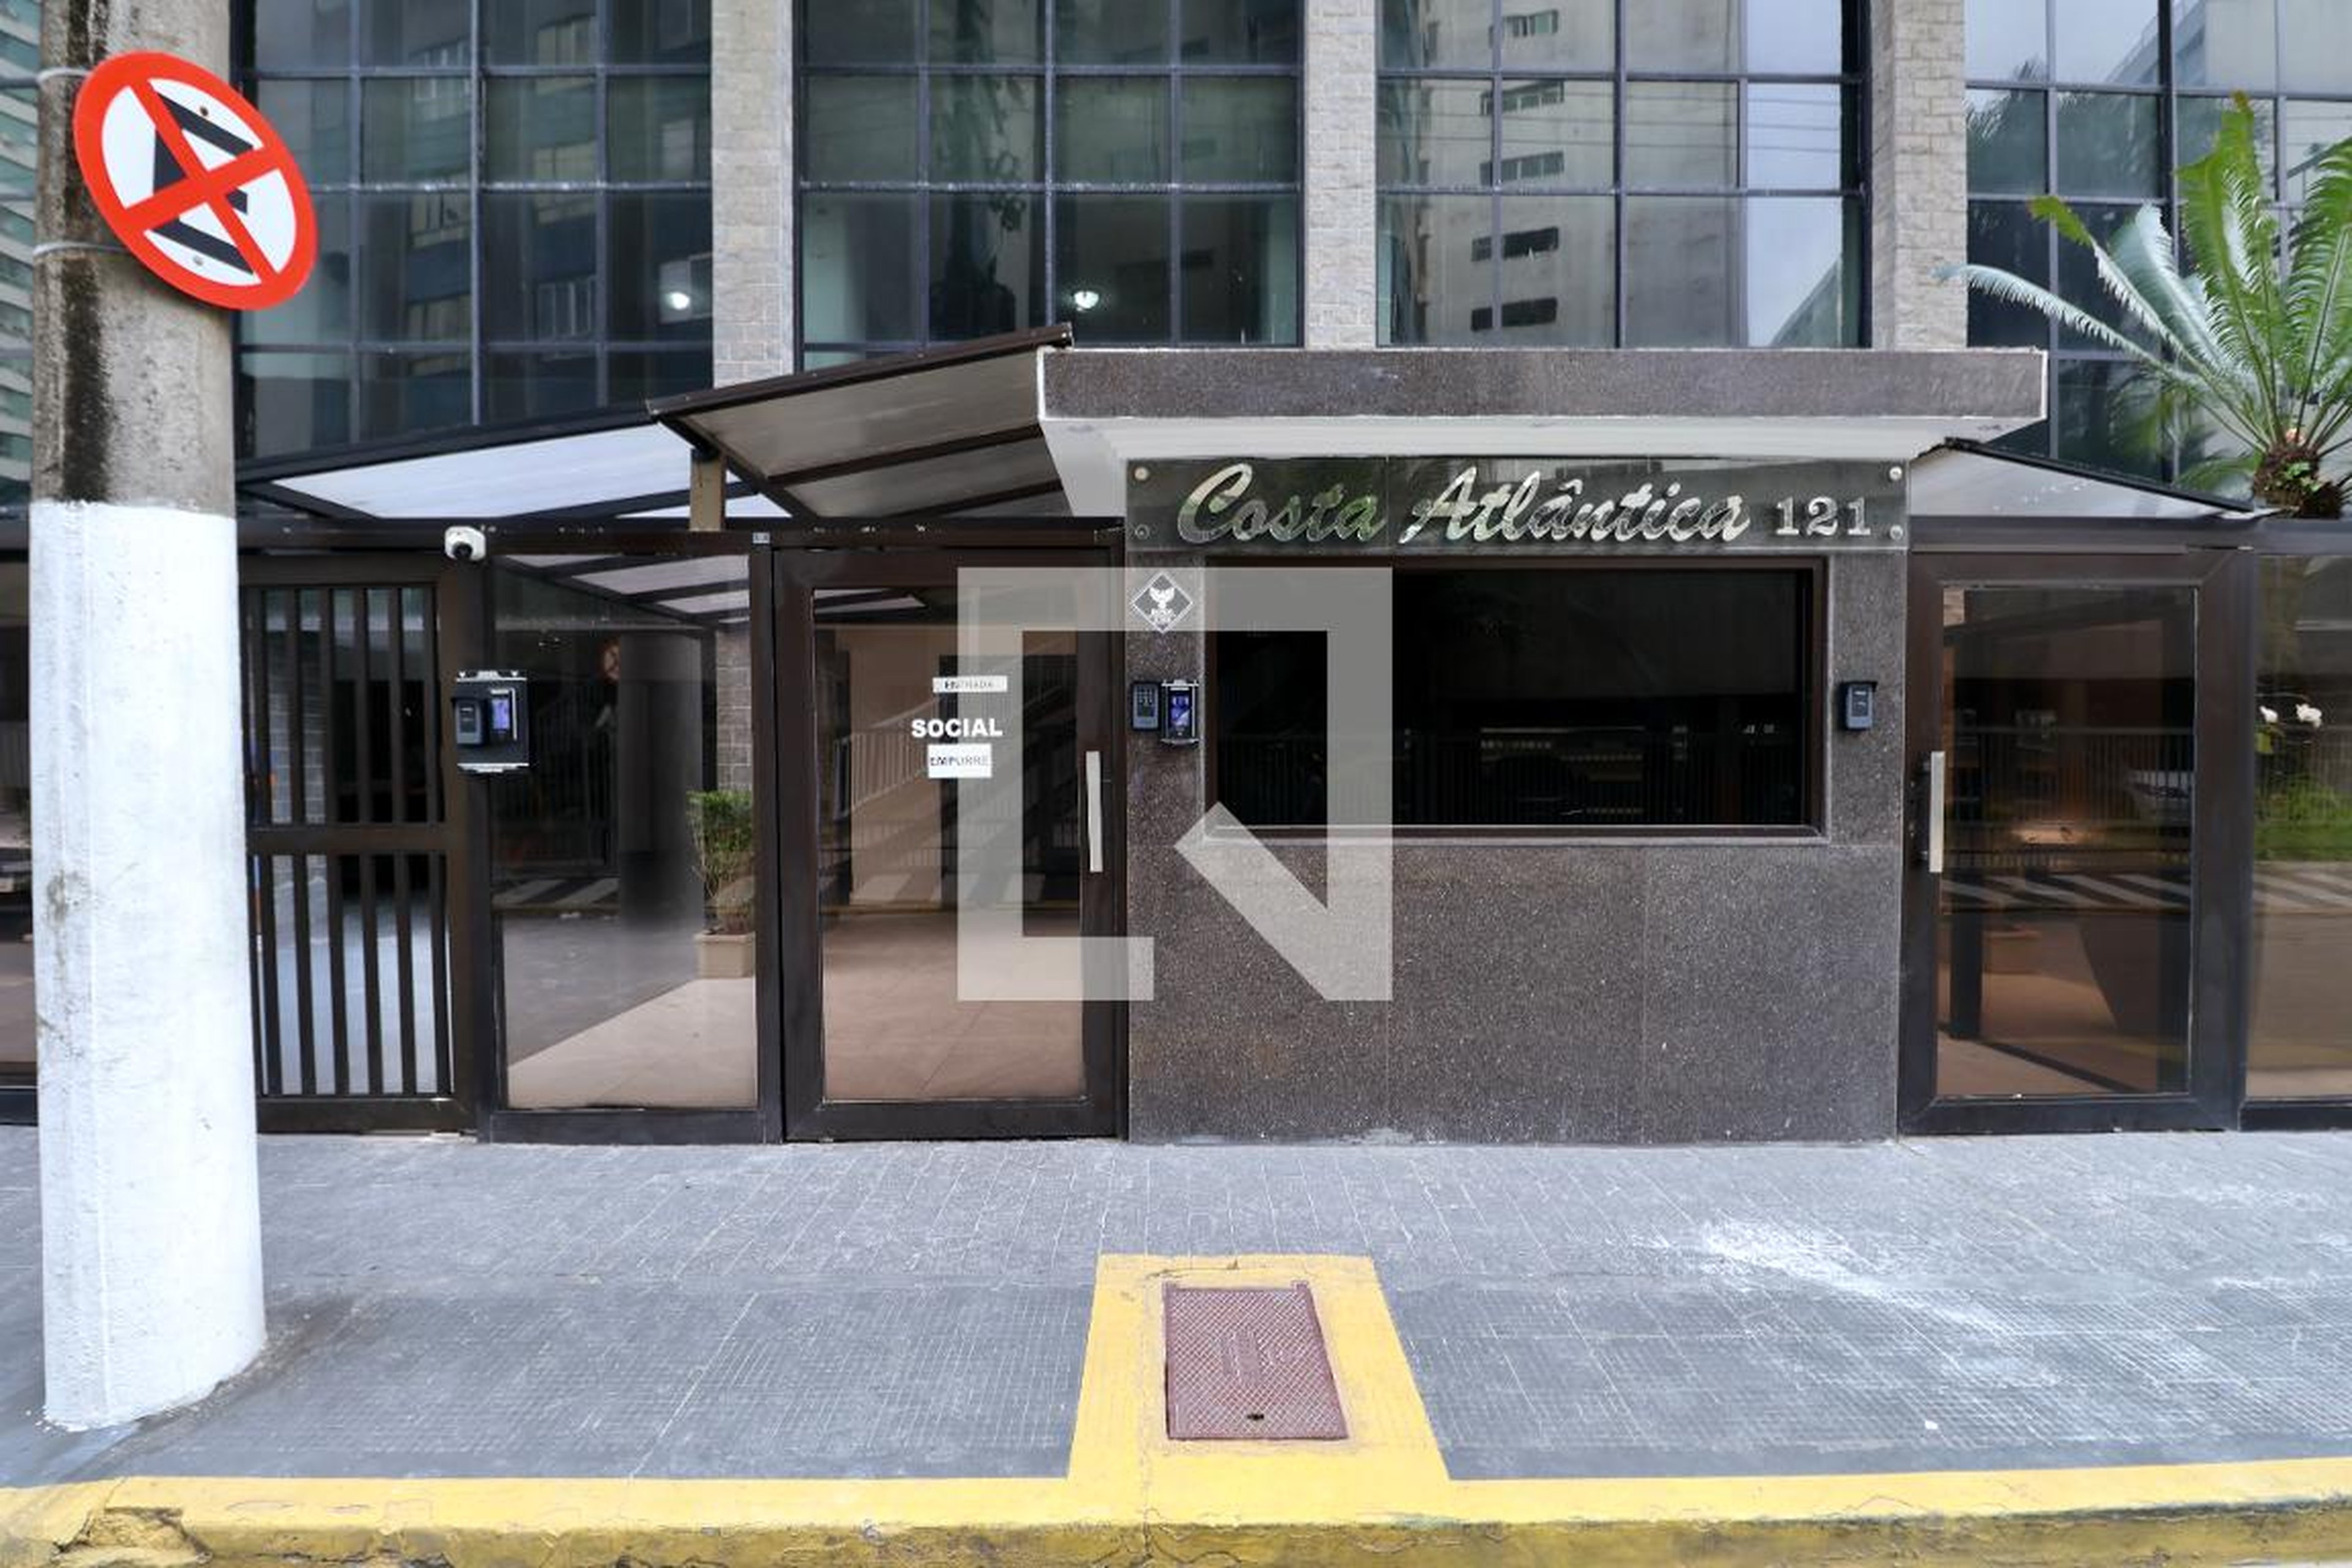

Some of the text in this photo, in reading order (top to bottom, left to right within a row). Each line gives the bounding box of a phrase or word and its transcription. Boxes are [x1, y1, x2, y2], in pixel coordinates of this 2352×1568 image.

[1177, 463, 1871, 544] Costa Atlântica 121
[911, 718, 1003, 738] SOCIAL
